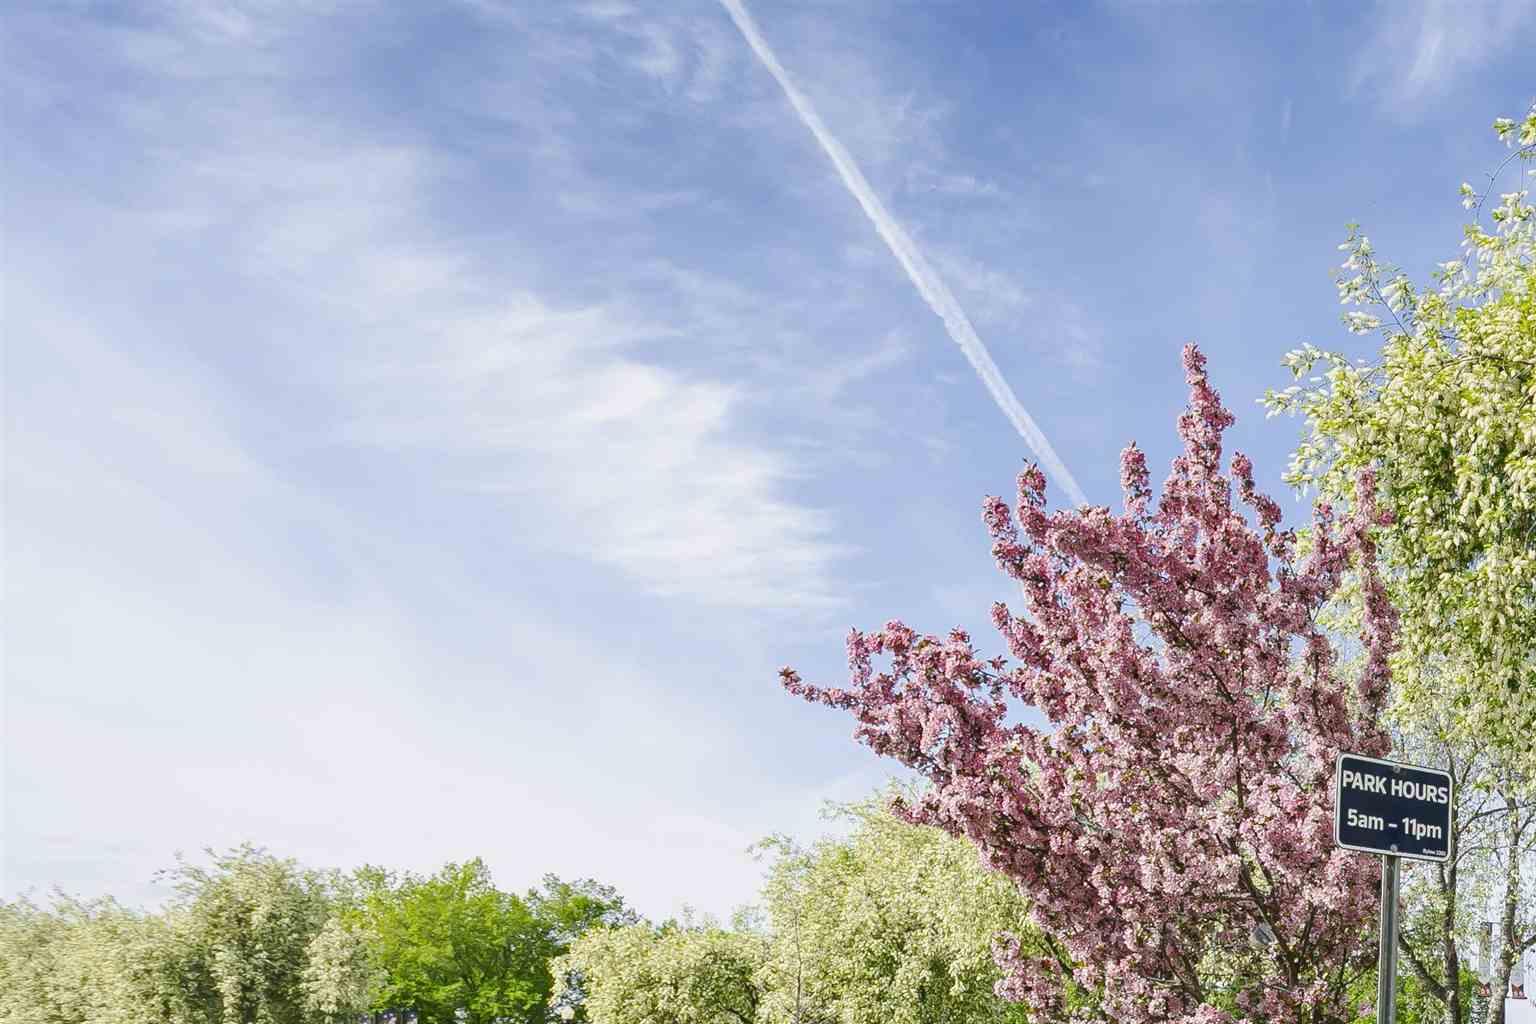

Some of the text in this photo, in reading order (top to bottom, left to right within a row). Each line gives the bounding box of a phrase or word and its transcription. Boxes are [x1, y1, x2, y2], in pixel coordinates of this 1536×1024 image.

[1342, 770, 1449, 804] PARK HOURS
[1347, 808, 1384, 831] 5am
[1402, 817, 1442, 840] 11pm
